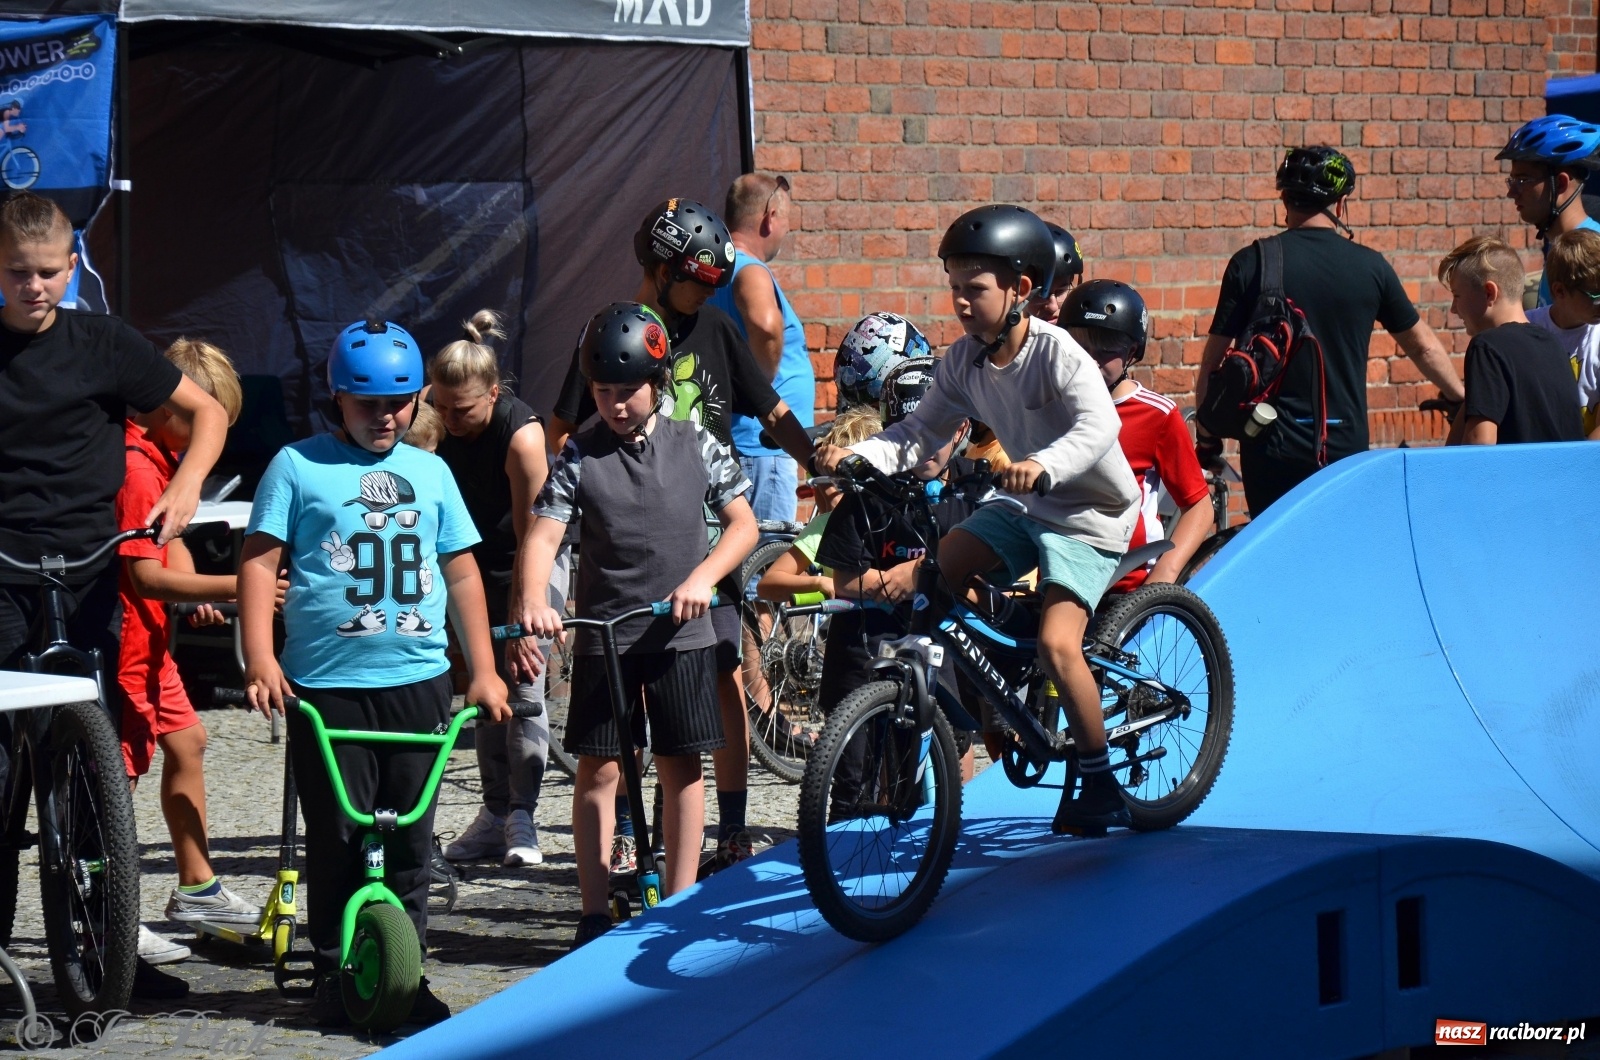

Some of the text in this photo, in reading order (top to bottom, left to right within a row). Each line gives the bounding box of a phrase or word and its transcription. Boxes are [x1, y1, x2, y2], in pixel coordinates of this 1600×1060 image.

[656, 228, 682, 246] SKATEPRO
[343, 530, 426, 608] 98
[1116, 725, 1131, 734] 20
